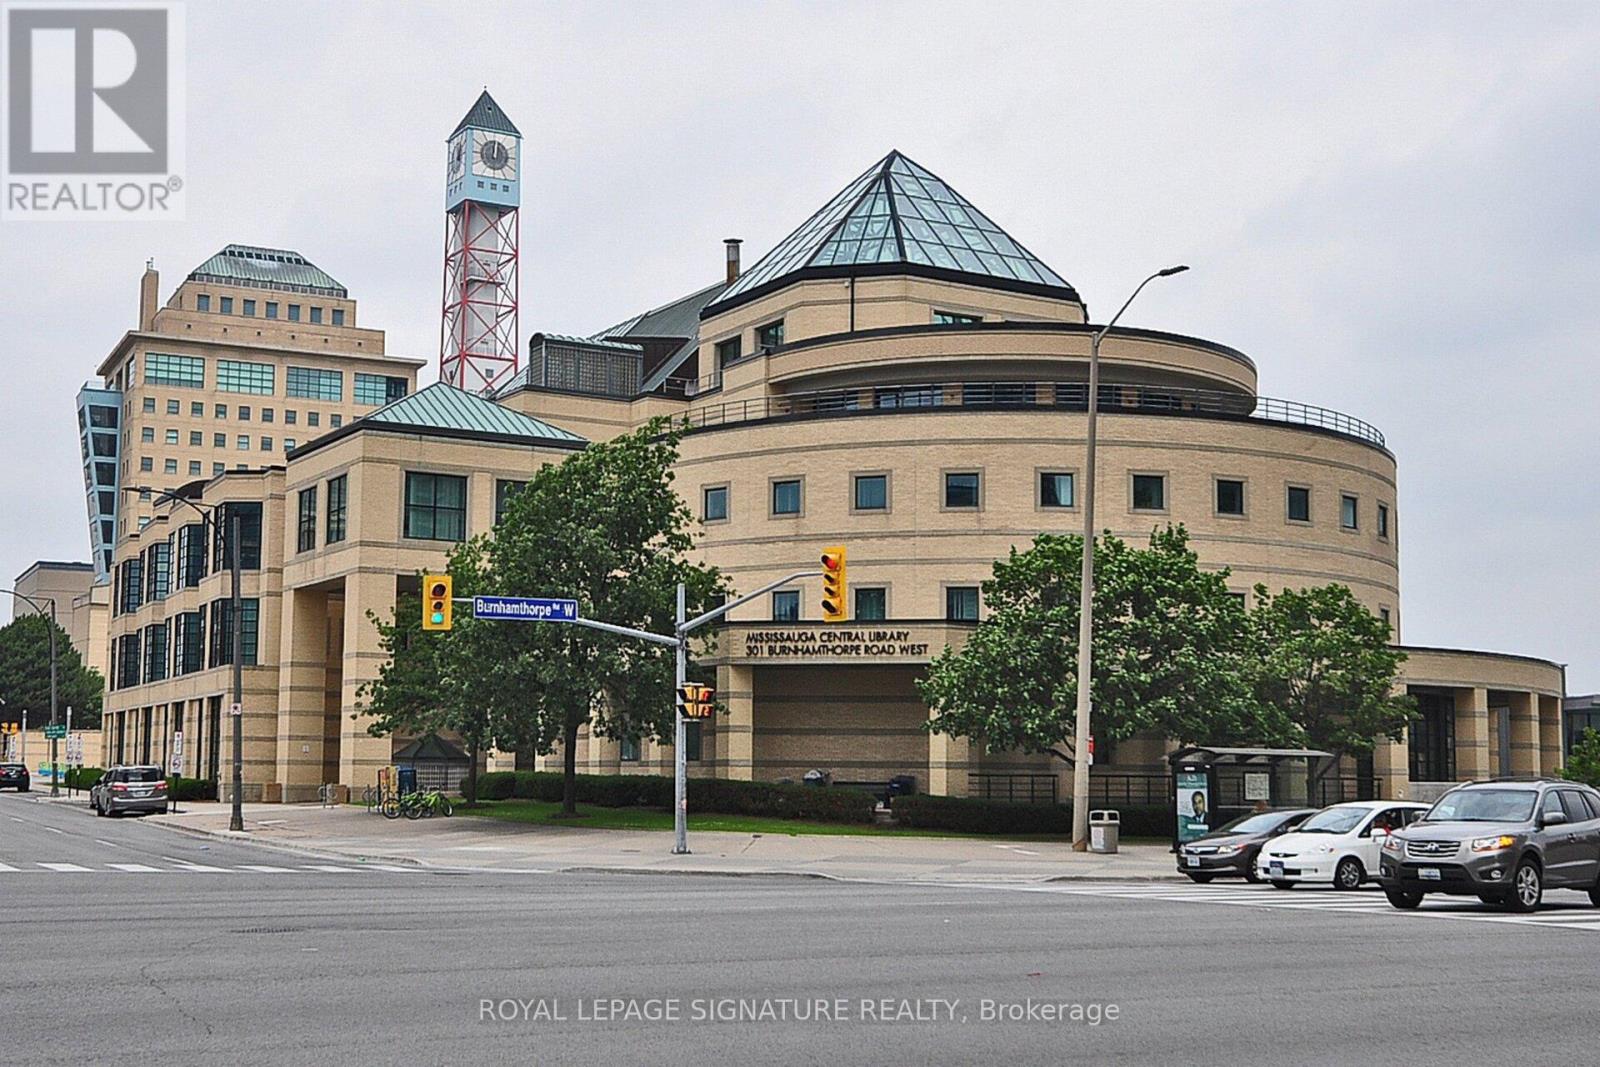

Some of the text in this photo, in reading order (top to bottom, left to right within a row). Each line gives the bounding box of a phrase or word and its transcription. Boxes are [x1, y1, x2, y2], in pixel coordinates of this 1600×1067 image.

[477, 599, 552, 618] Burnhamthorpe
[564, 603, 574, 617] W
[746, 631, 909, 643] MISSISSAUGA CENTRAL LIBRARY
[746, 644, 929, 656] 301 BURNHAMTHORPE ROAD WEST
